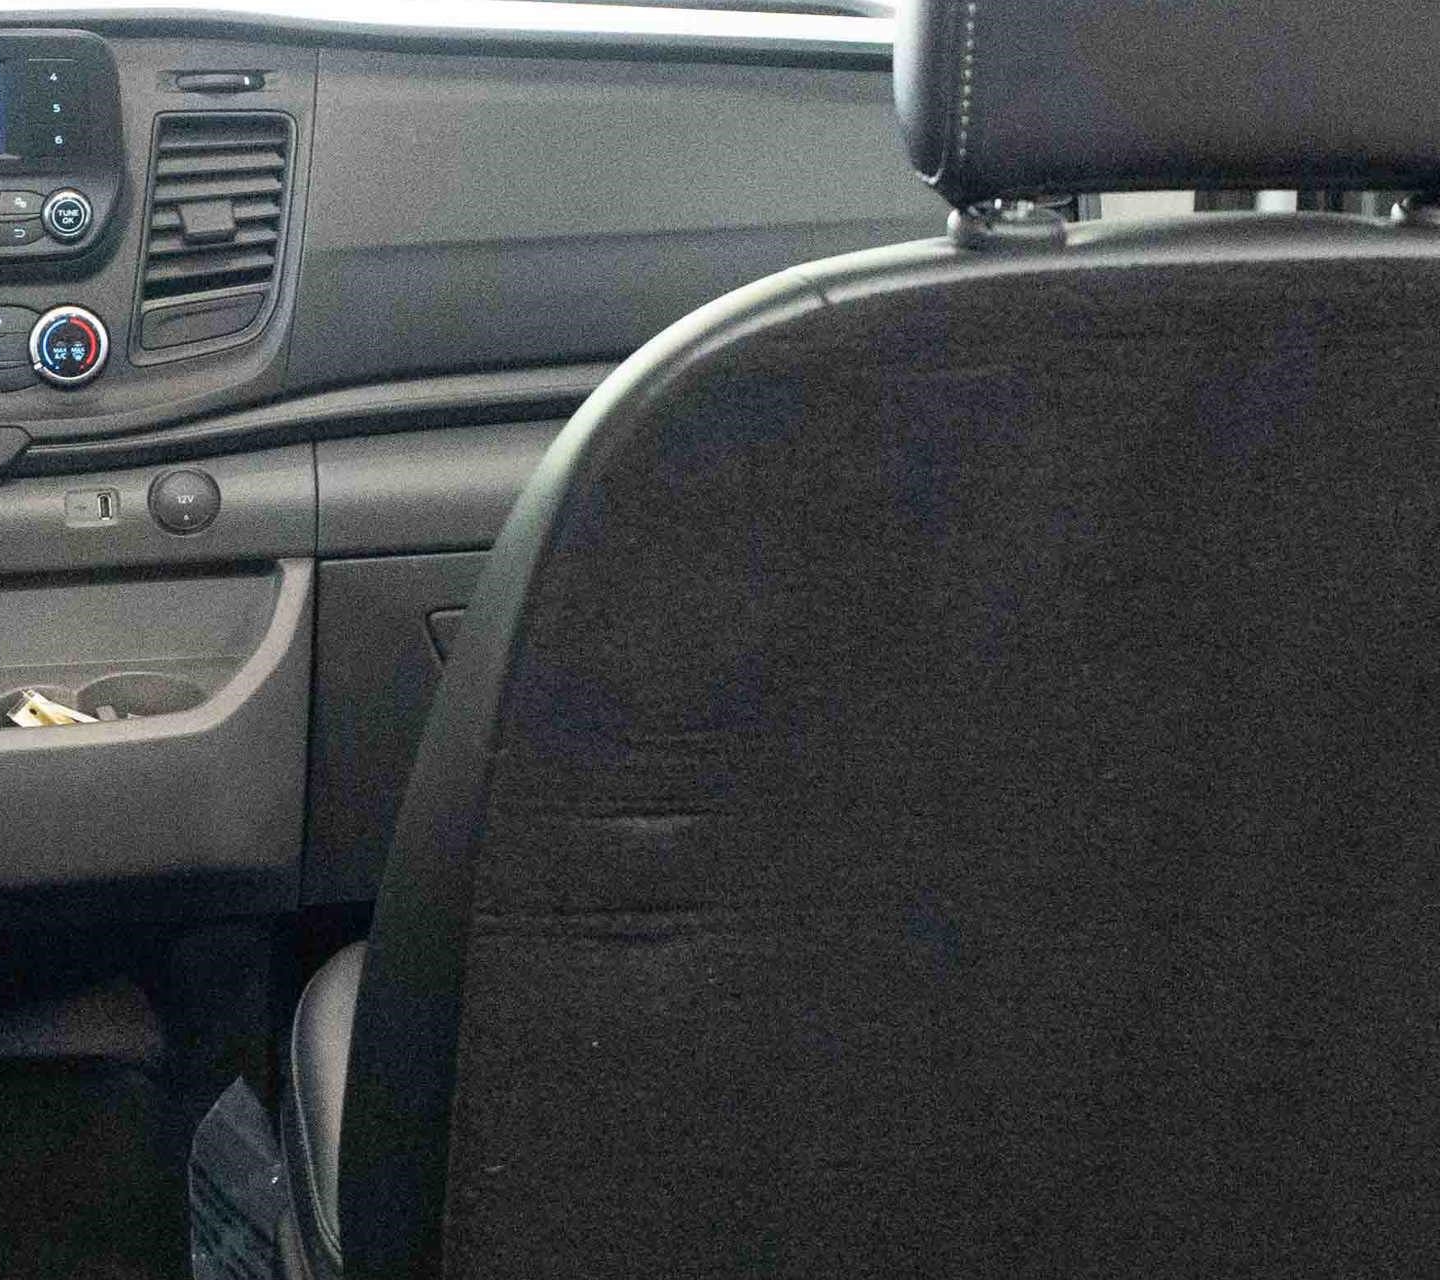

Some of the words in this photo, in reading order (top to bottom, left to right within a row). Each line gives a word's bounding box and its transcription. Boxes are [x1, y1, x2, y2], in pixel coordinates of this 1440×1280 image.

[49, 72, 58, 82] 4
[52, 104, 61, 114] 5
[54, 135, 63, 145] 6
[57, 209, 80, 219] TUNE
[62, 217, 75, 226] OK
[176, 494, 195, 505] 12V
